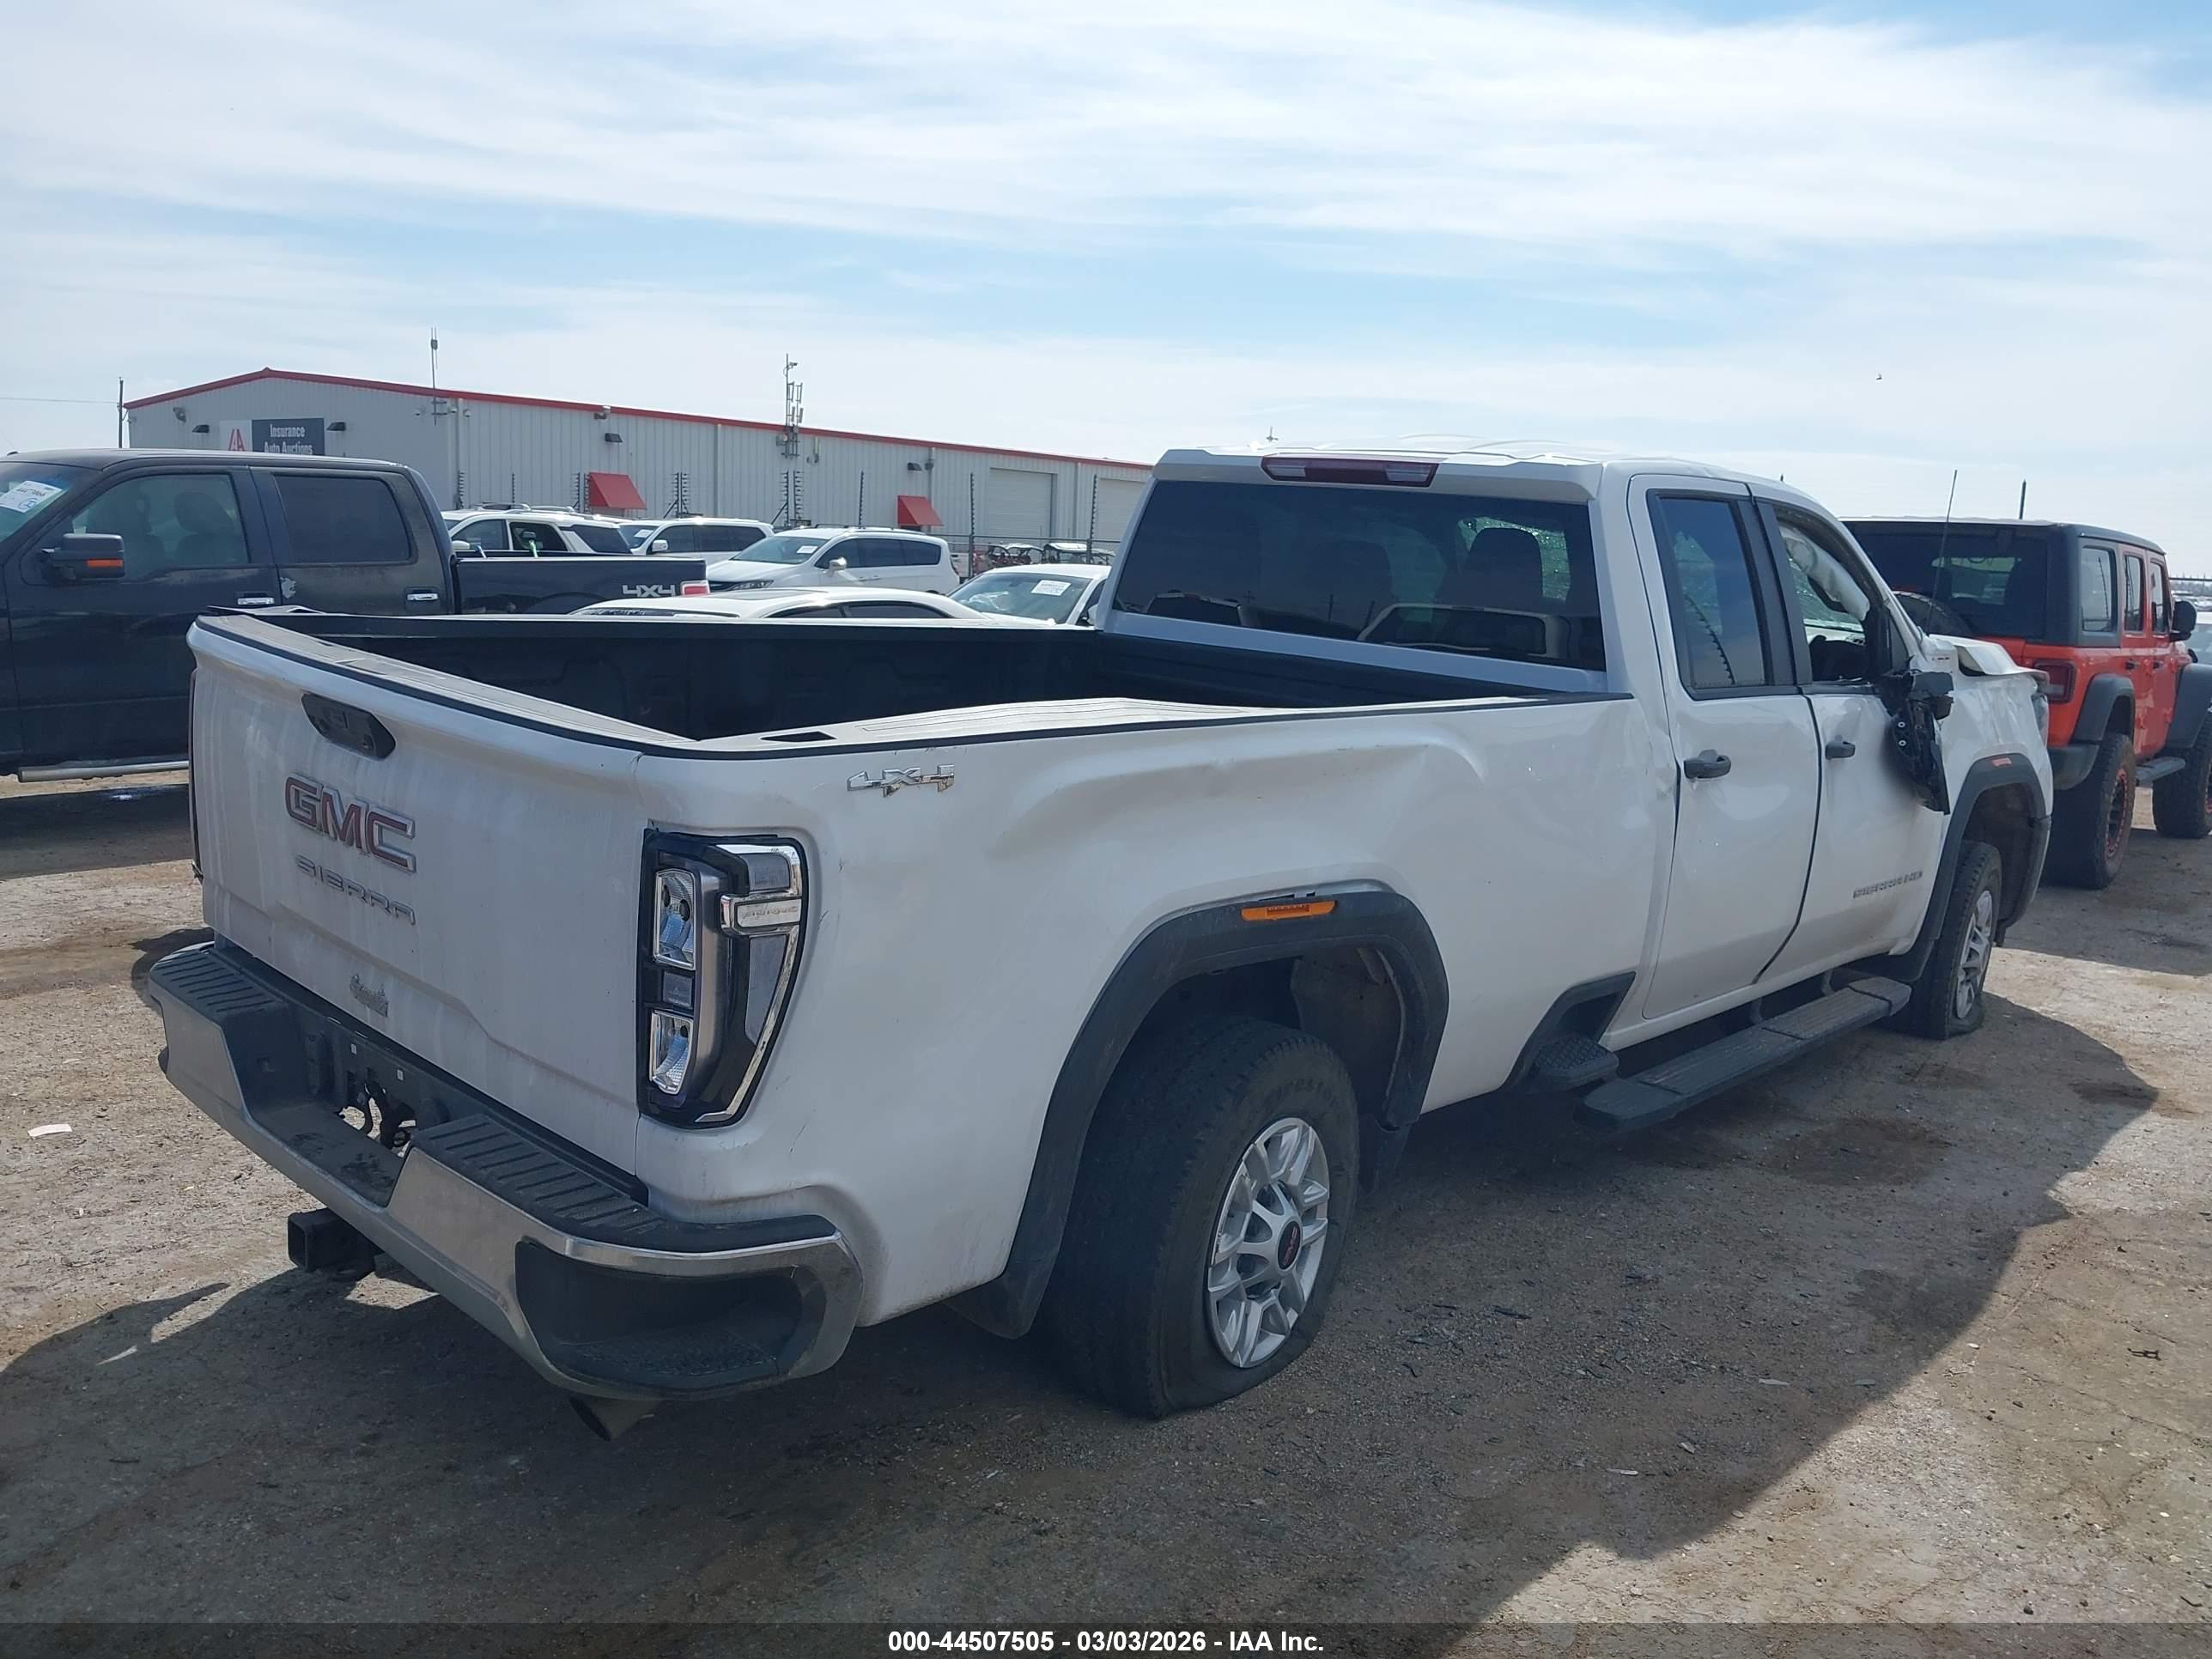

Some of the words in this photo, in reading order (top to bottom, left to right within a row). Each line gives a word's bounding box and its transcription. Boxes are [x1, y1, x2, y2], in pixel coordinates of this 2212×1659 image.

[264, 441, 280, 454] Auto
[282, 441, 313, 456] Auctions
[269, 423, 306, 438] Insurance
[285, 773, 417, 874] GMC
[295, 854, 417, 926] SIERRA
